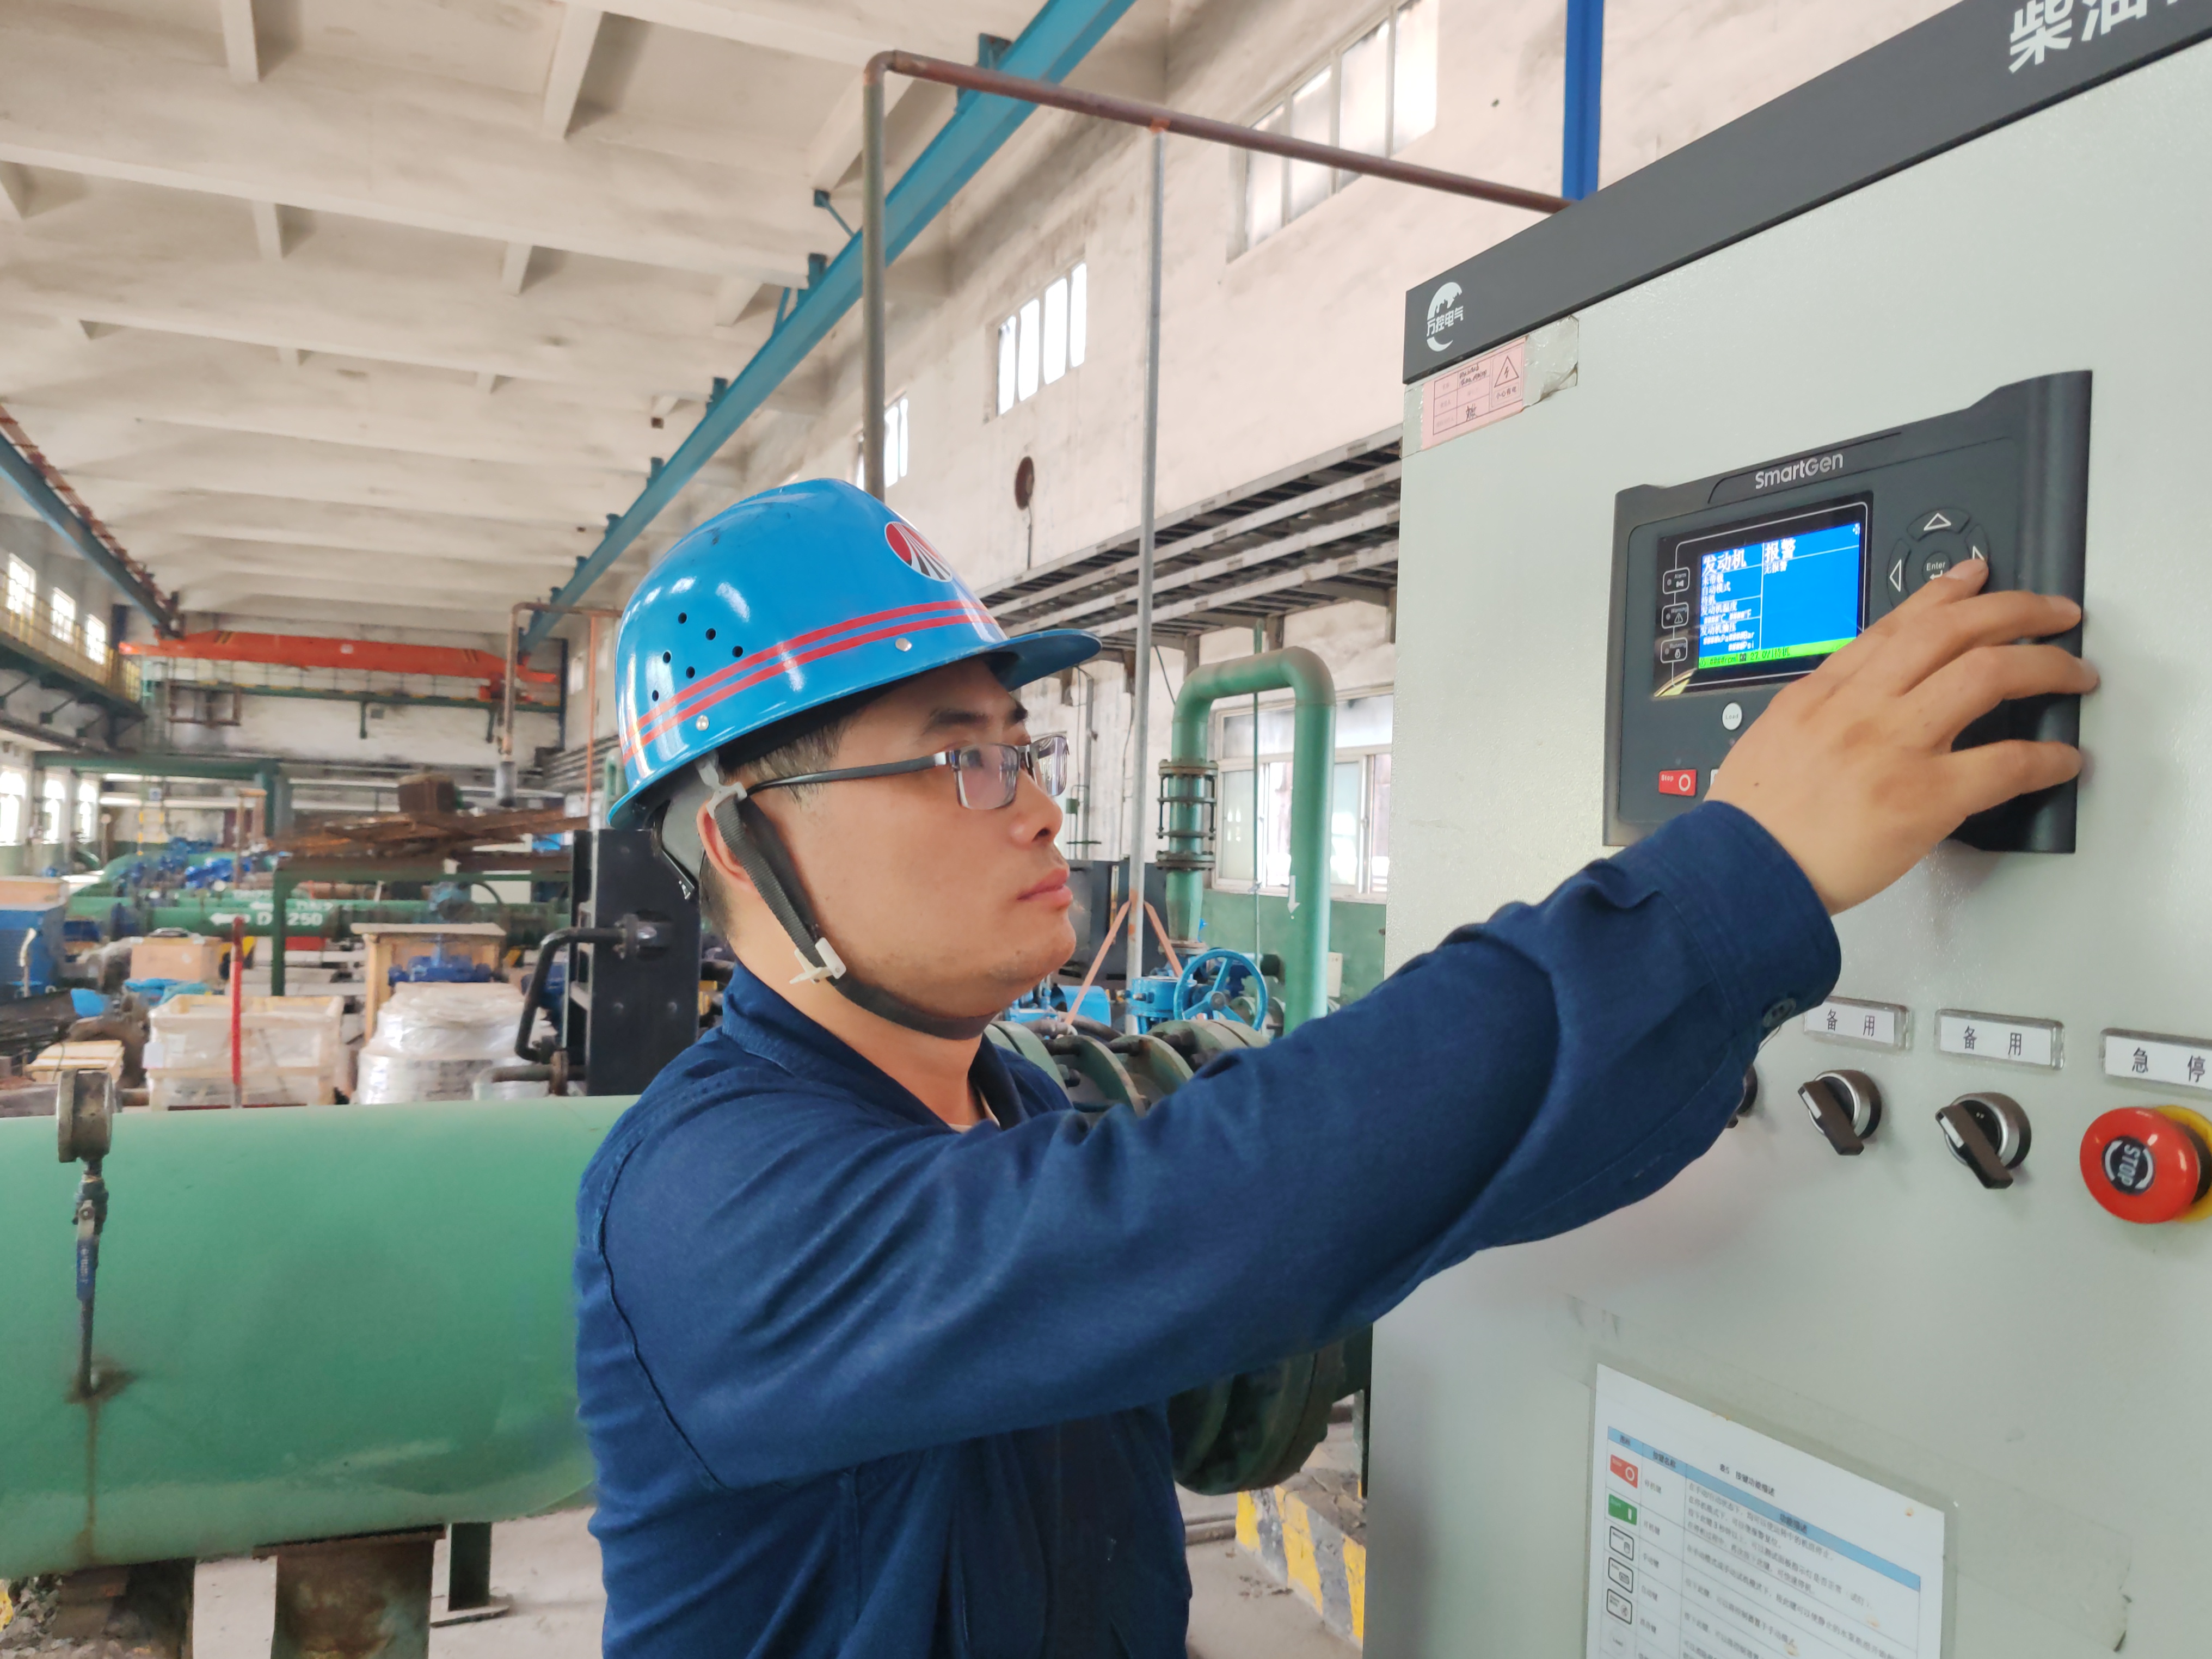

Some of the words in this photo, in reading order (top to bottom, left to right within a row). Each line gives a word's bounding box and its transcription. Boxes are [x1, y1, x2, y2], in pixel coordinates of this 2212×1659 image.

[2008, 0, 2177, 73] 柴油
[1427, 305, 1464, 337] 万控电气
[1755, 453, 1844, 489] SmartGen
[1702, 549, 1747, 575] 发动机
[1765, 537, 1796, 563] 报警
[1764, 561, 1787, 575] 无报警
[1926, 561, 1945, 571] Enter
[1702, 581, 1731, 595] 自动模式
[1700, 622, 1736, 637] 发动机油压
[1827, 1009, 1875, 1037] 备用
[1963, 1025, 2023, 1057] 备用
[2131, 1047, 2206, 1083] 急停
[2117, 1144, 2141, 1187] STOP
